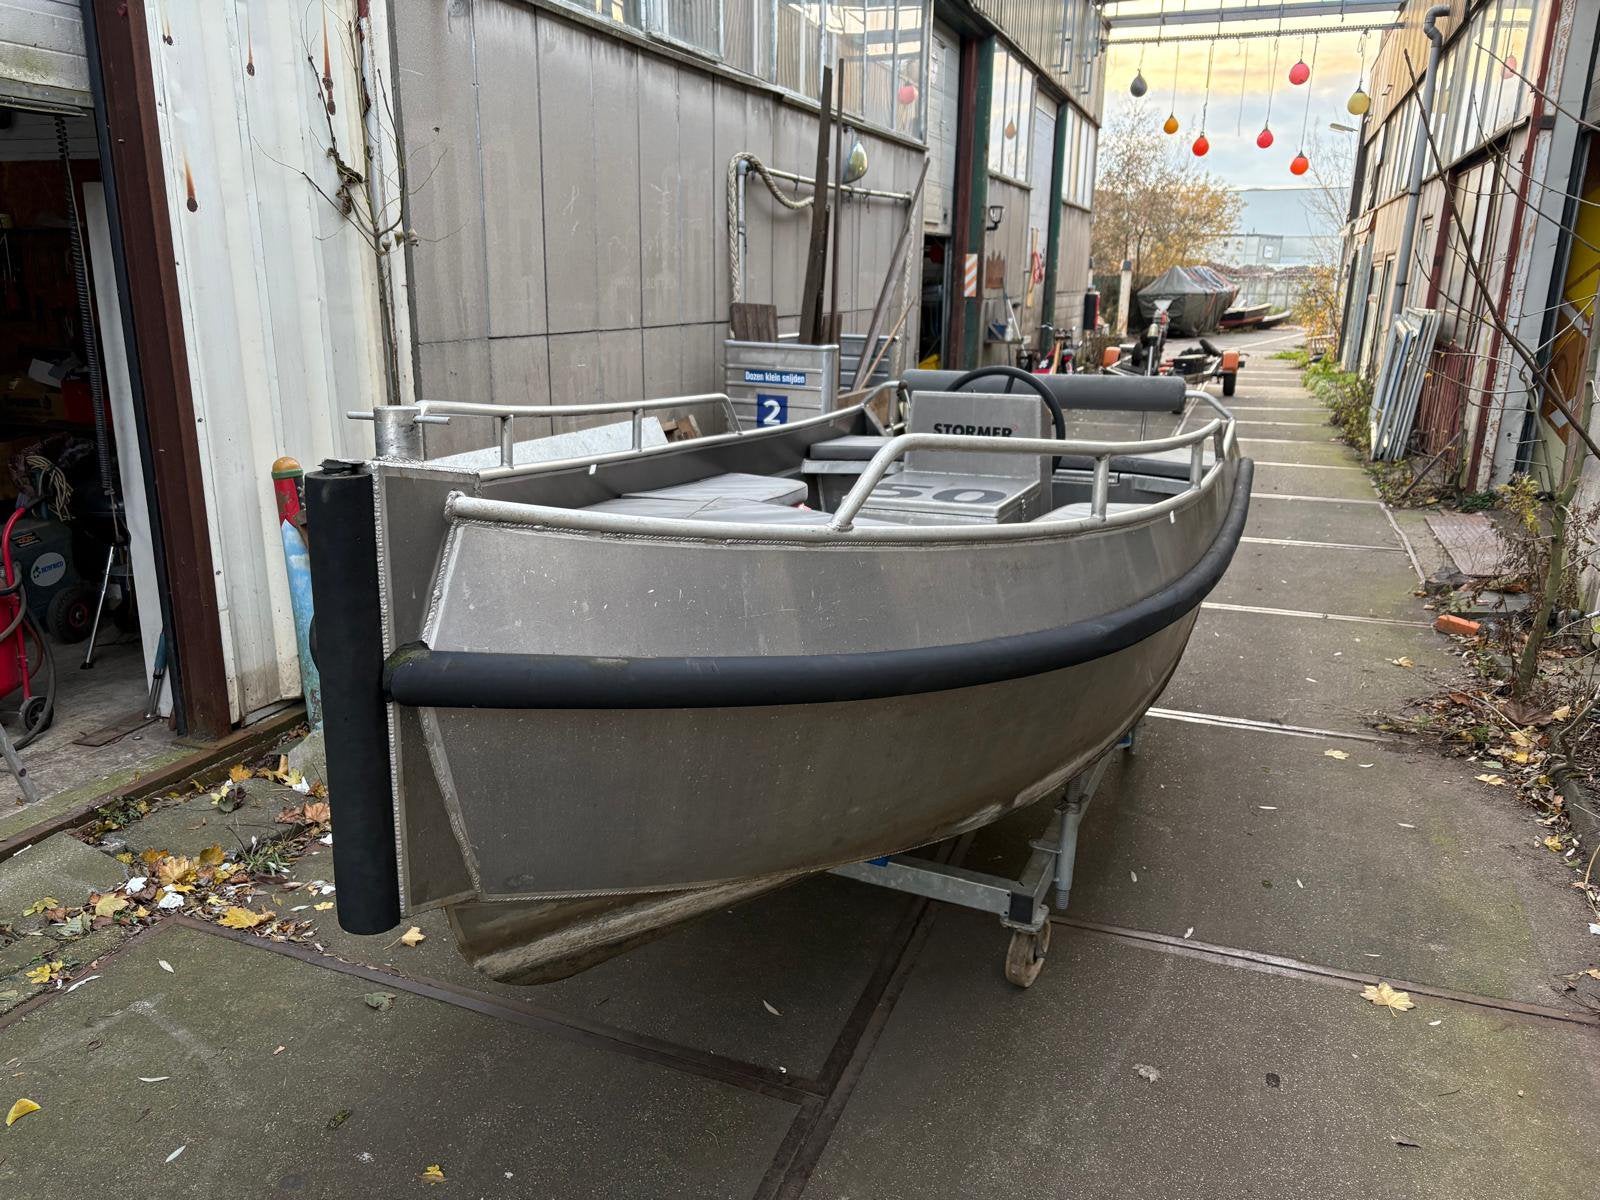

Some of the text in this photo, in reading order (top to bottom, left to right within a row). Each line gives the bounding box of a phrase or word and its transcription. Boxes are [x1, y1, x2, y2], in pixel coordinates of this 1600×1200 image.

[745, 371, 806, 384] Dozen klein snijden
[763, 400, 781, 425] 2
[933, 423, 1013, 437] STORMER
